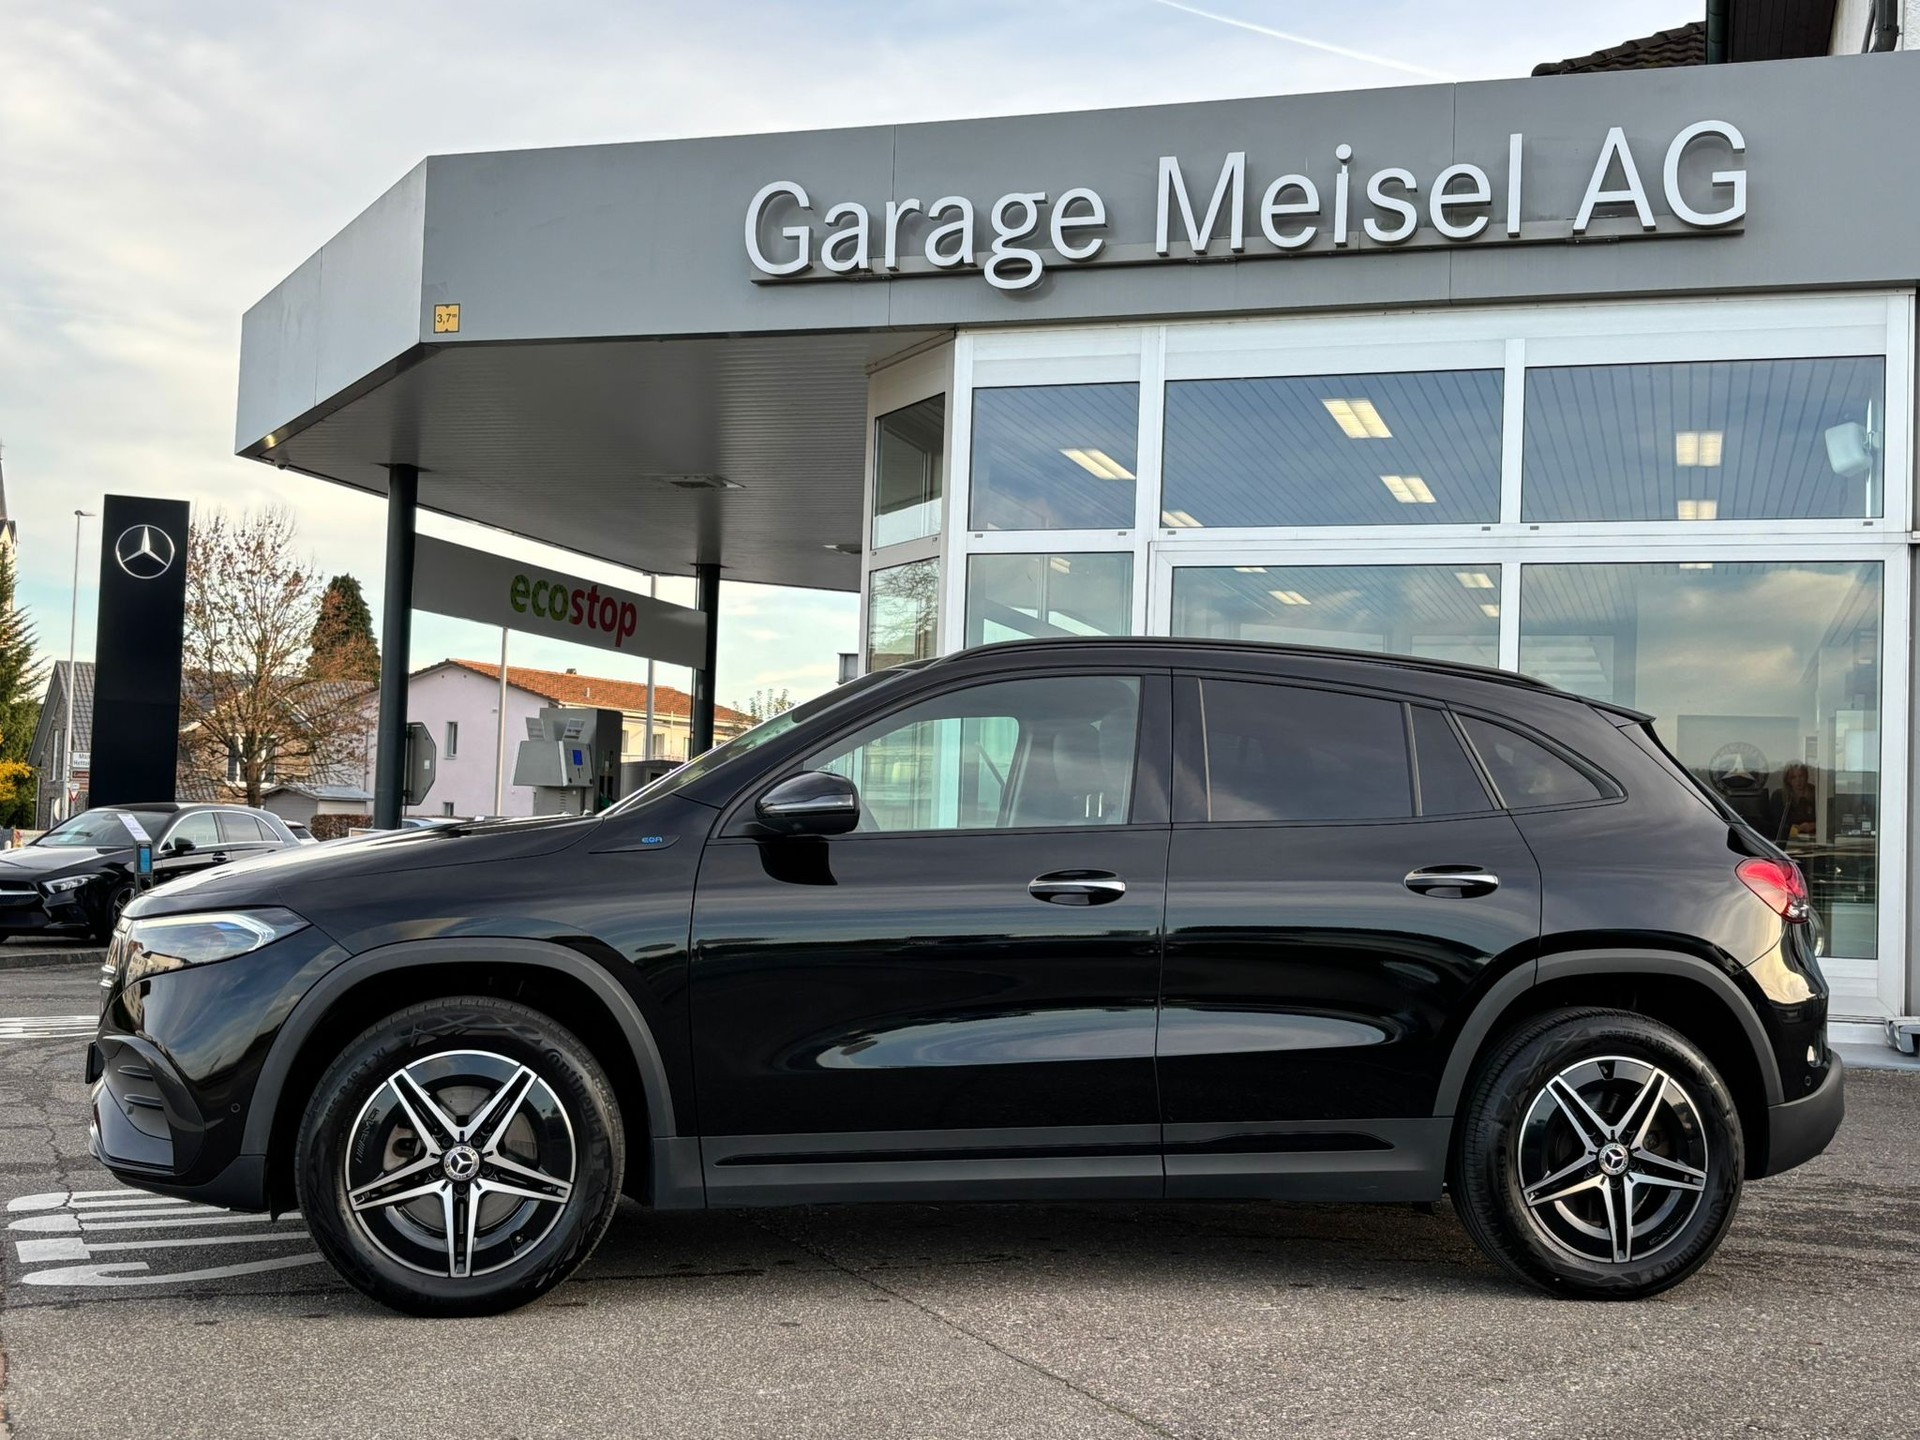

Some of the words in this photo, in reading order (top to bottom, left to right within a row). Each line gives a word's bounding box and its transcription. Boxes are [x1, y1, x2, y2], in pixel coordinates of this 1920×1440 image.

[745, 180, 1107, 292] Garage
[1155, 133, 1523, 257] Meisel
[1572, 119, 1749, 236] AG
[510, 574, 637, 648] ecostop
